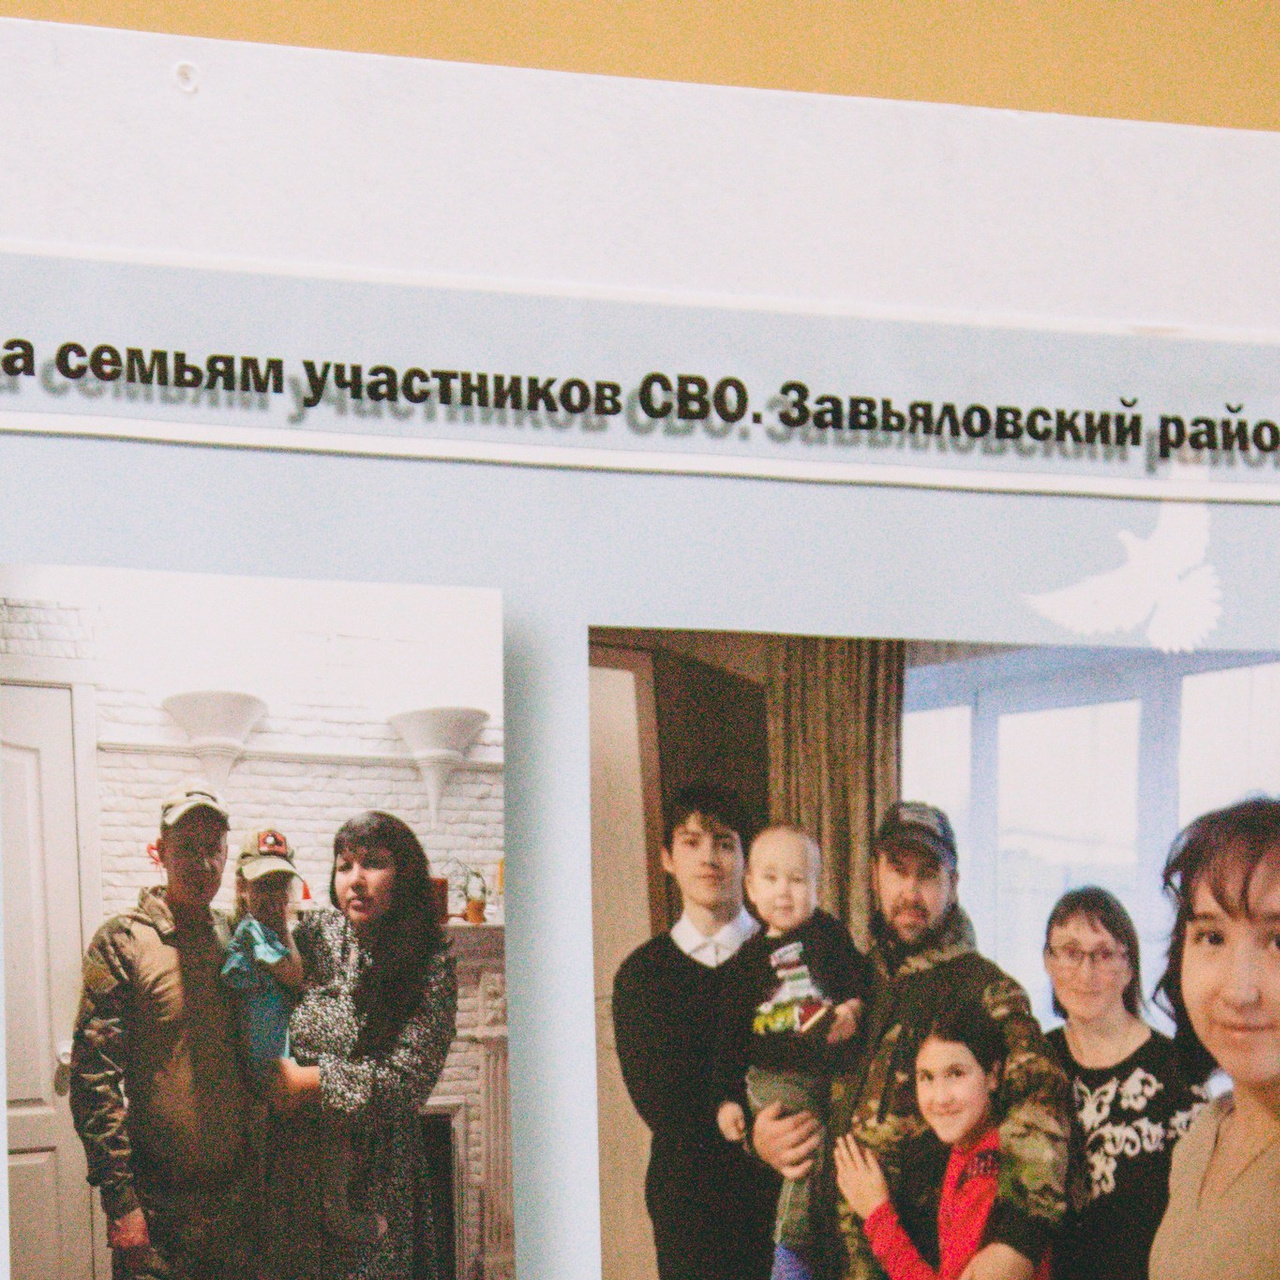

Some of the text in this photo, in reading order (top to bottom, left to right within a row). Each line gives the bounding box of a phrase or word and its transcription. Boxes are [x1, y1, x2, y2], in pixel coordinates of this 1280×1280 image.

[55, 342, 284, 394] семьям
[303, 360, 623, 416] участников
[638, 372, 762, 425] СВО.
[778, 381, 1142, 447] Завьяловский
[1158, 402, 1280, 458] райо
